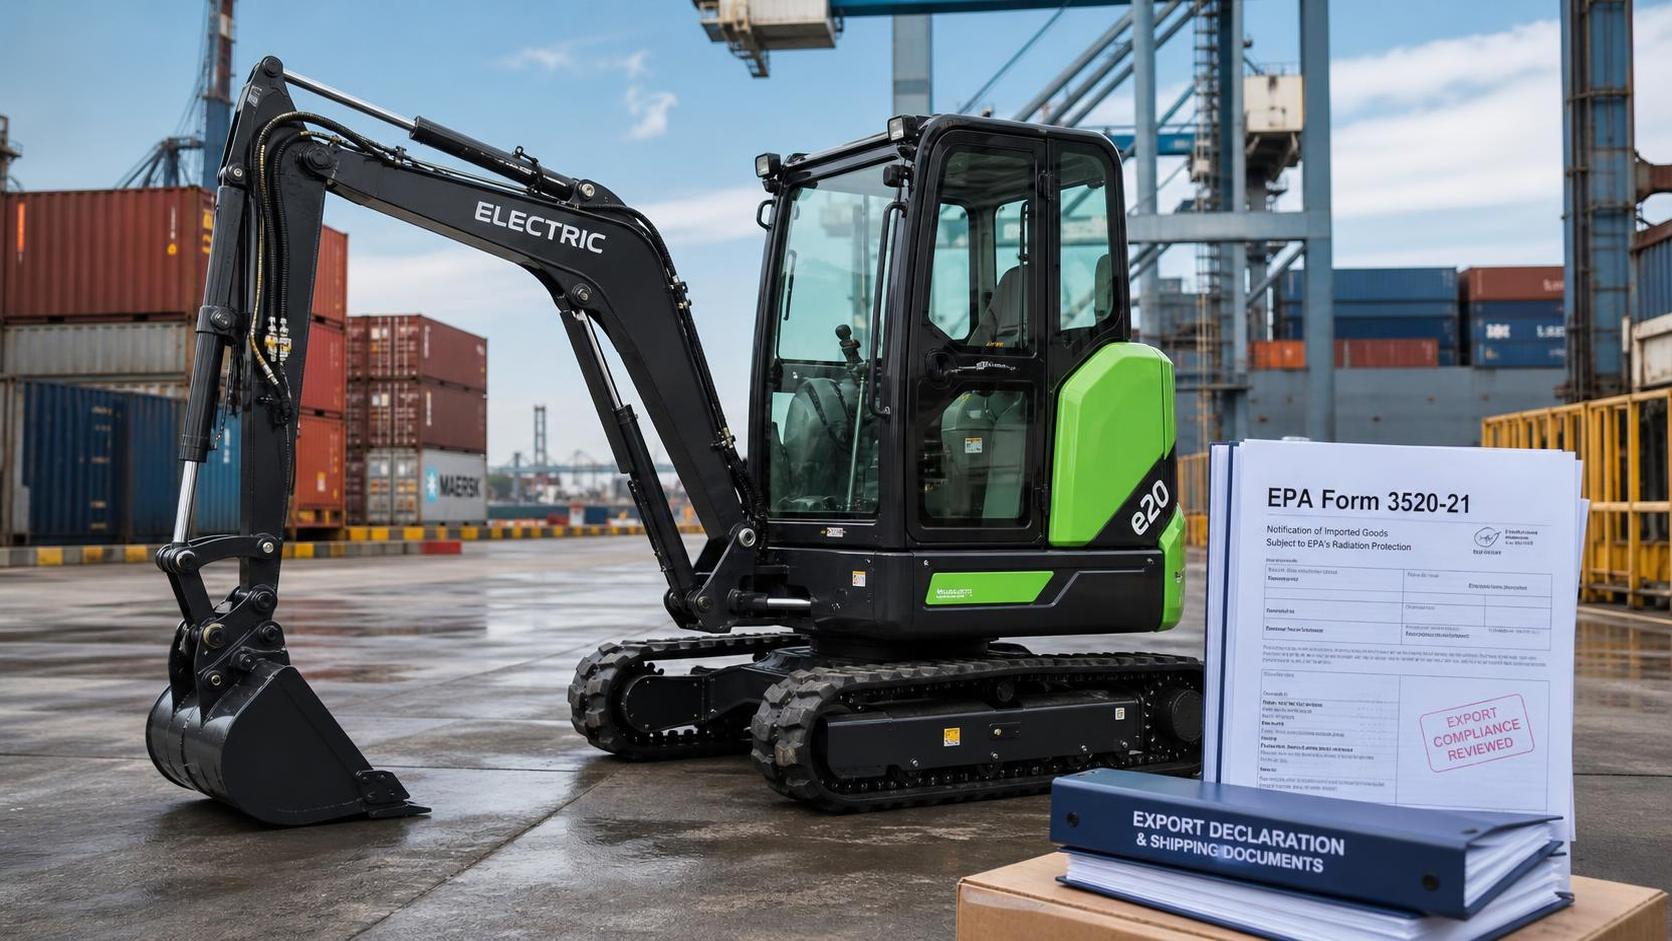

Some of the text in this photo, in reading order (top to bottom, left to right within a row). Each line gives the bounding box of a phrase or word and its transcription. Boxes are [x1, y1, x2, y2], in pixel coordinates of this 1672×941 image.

[474, 200, 607, 254] ELECTRIC
[439, 473, 481, 498] MAERSK
[1131, 479, 1170, 536] e20
[1268, 487, 1471, 514] EPA Form 3520-21
[1266, 525, 1389, 538] Notification of Imported Goods
[1266, 538, 1412, 551] Subject to EPA's Radiation Protection
[1446, 706, 1497, 728] EXPORT
[1433, 718, 1521, 748] COMPLIANCE
[1448, 737, 1514, 761] REVIEWED
[1132, 810, 1345, 856] EXPORT DECLARATION
[1136, 832, 1324, 873] & SHIPPING DOCUMENTS
